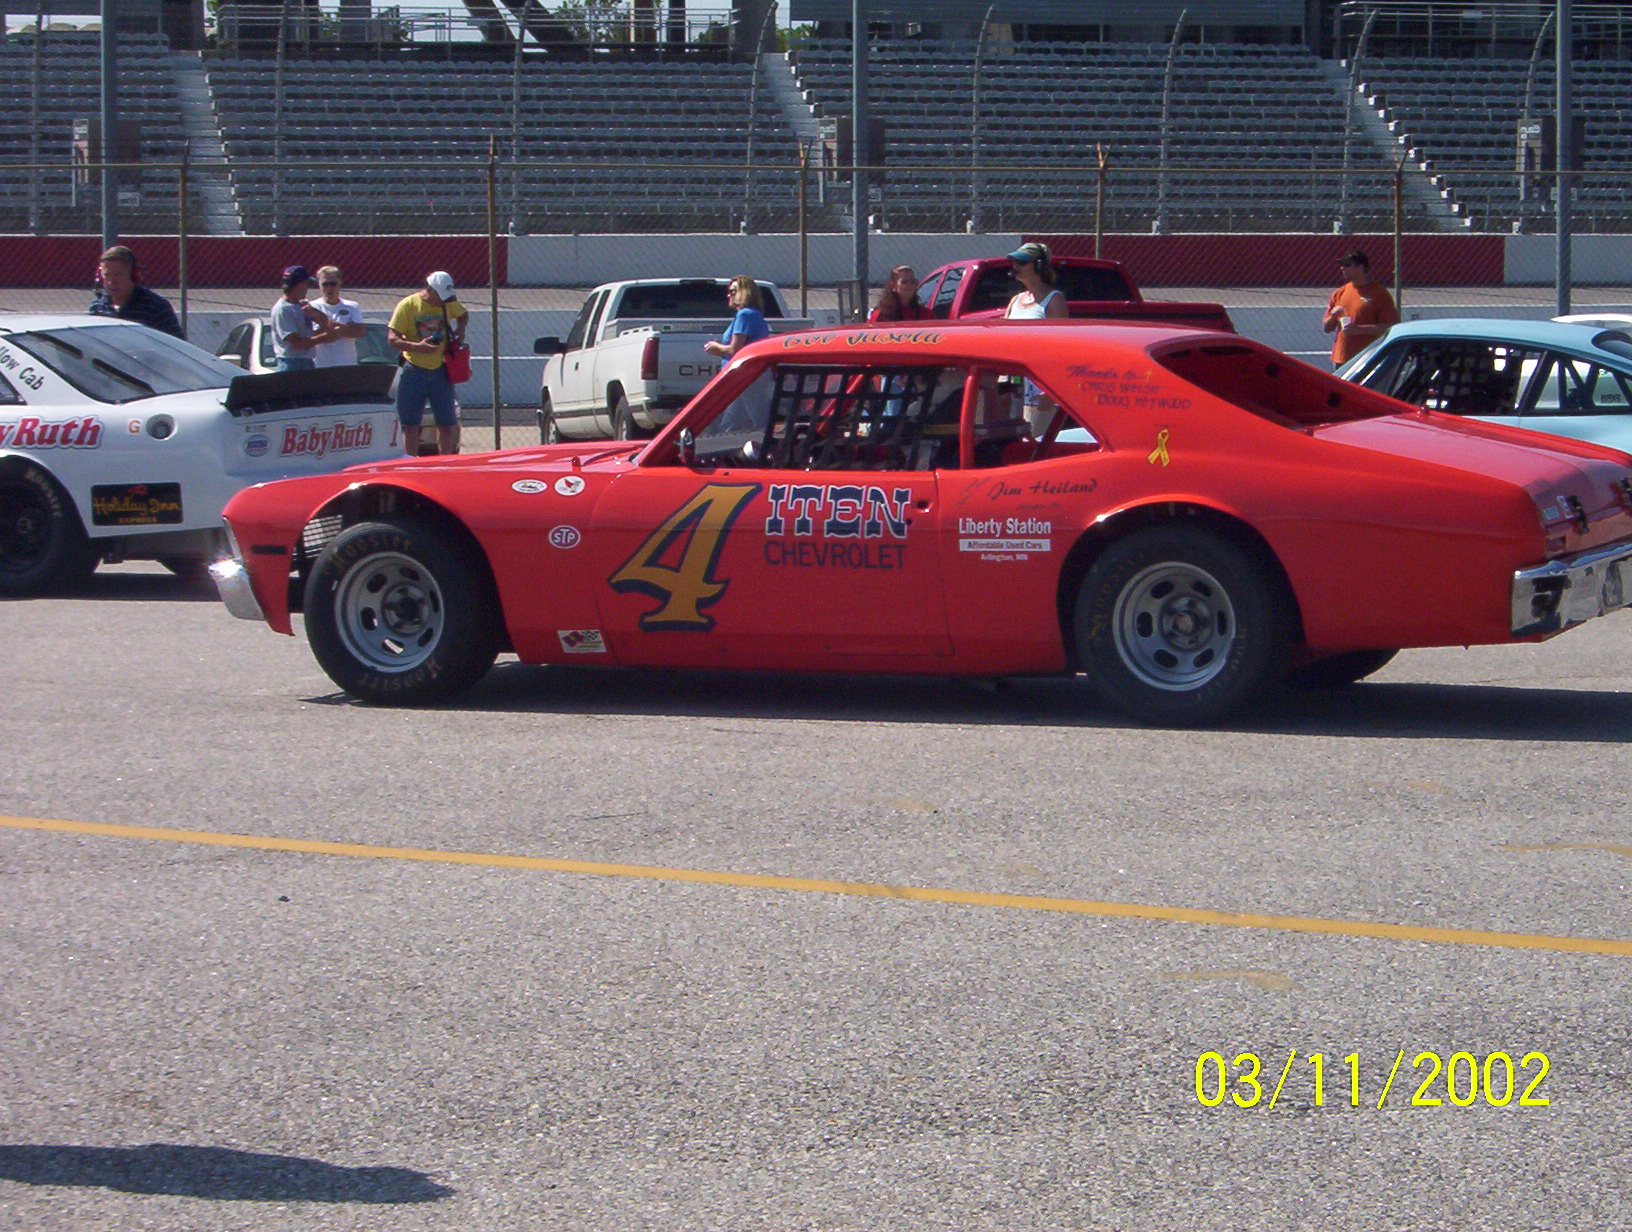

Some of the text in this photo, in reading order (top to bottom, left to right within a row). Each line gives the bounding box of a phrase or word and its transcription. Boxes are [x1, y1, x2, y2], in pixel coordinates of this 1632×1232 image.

[19, 366, 45, 391] Cab
[128, 419, 141, 433] G
[986, 478, 1098, 501] Jim Heiland
[764, 484, 912, 538] ITEN
[553, 528, 576, 544] STP
[959, 517, 1052, 537] Liberty Station
[764, 540, 907, 570] CHEVROLET
[1006, 541, 1024, 549] Used
[1025, 541, 1043, 549] Cars
[607, 482, 762, 633] 4
